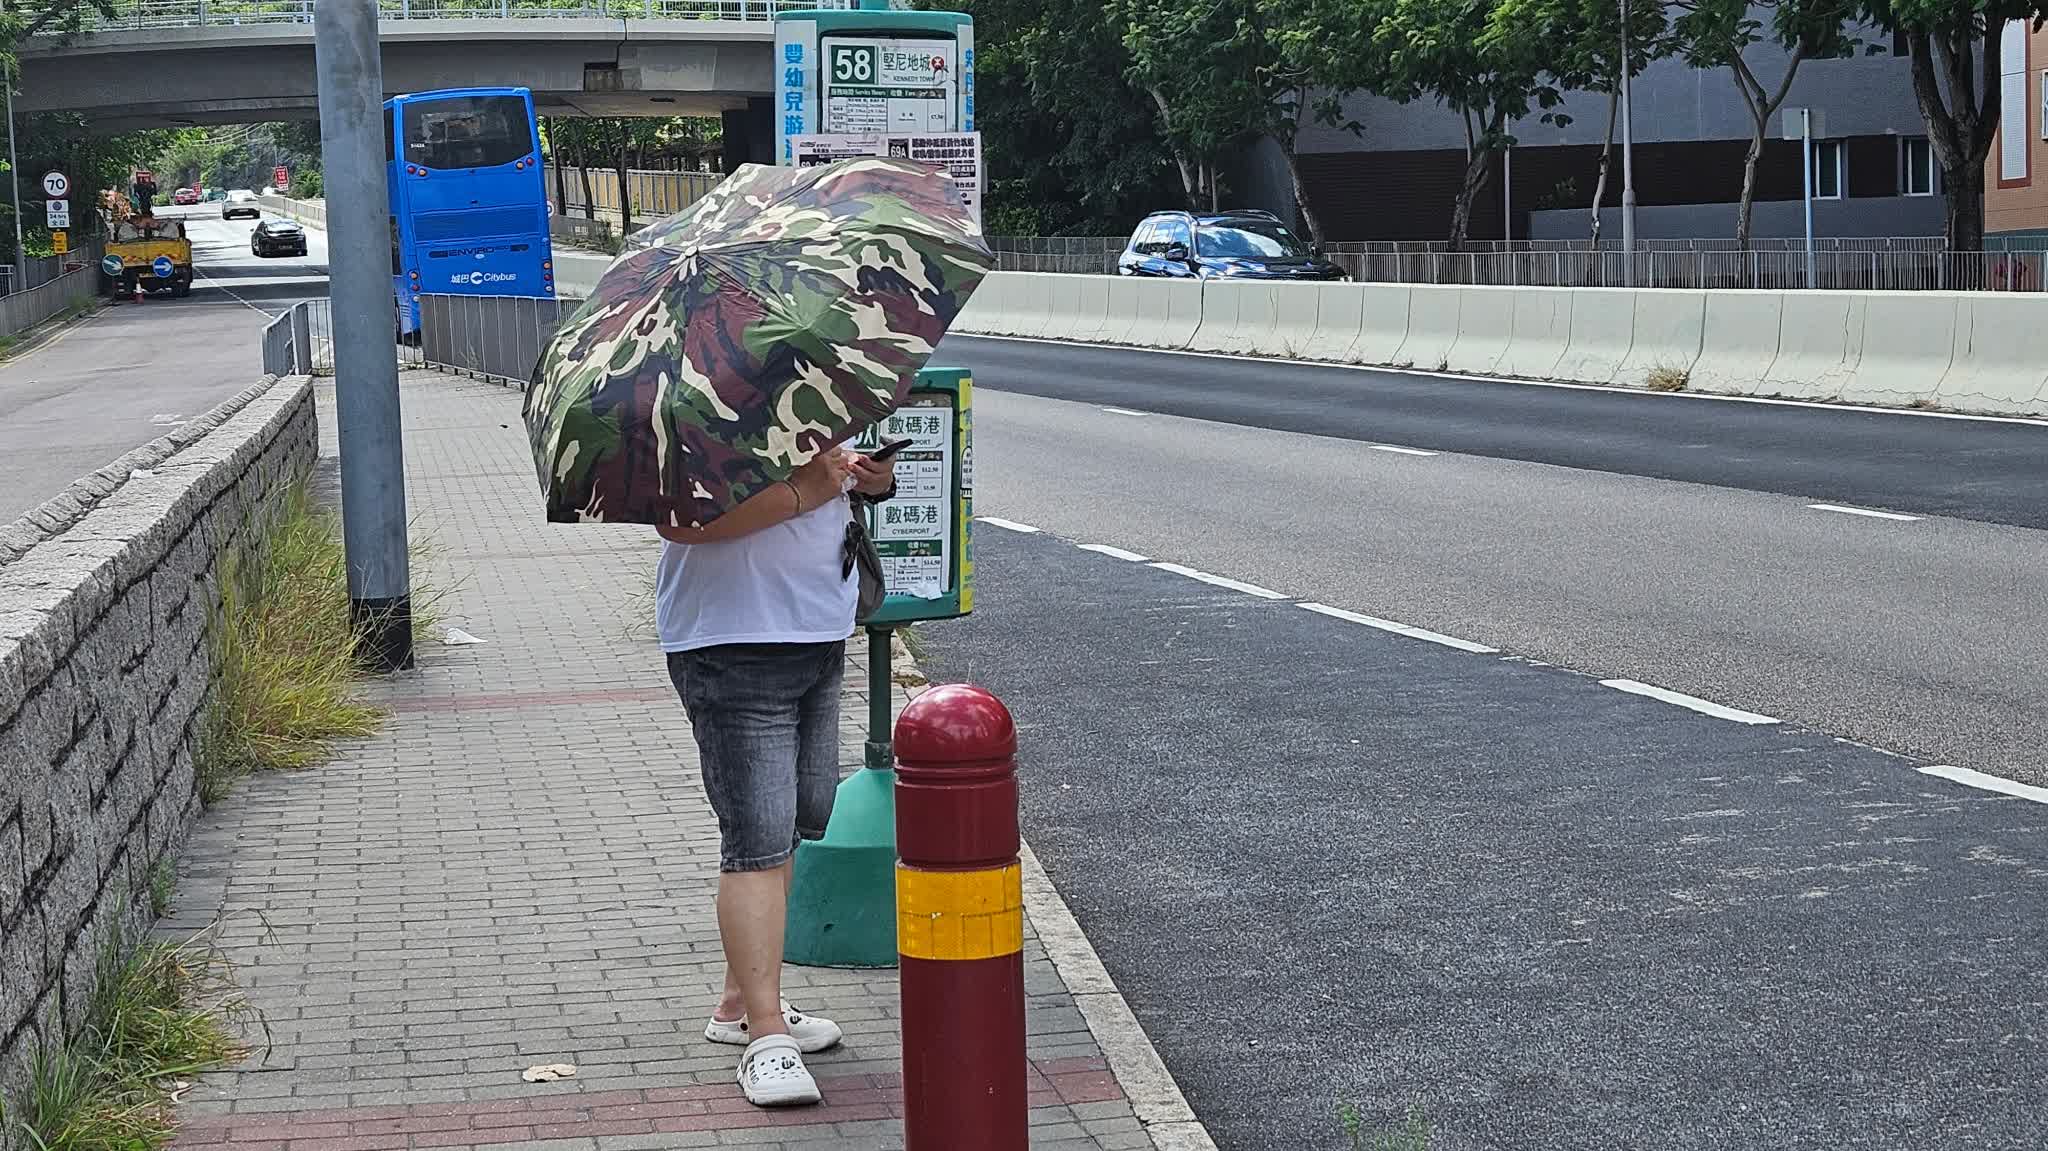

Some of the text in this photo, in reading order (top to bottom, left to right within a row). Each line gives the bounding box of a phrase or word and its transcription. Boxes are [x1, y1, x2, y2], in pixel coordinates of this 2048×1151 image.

[836, 49, 871, 80] 58
[883, 52, 931, 71] 堅尼地城
[890, 145, 907, 158] 69A
[46, 178, 65, 191] 70
[483, 271, 517, 282] Citybus
[888, 415, 940, 435] 數碼港
[885, 505, 938, 525] 數碼港
[892, 527, 930, 535] CYBERPORT
